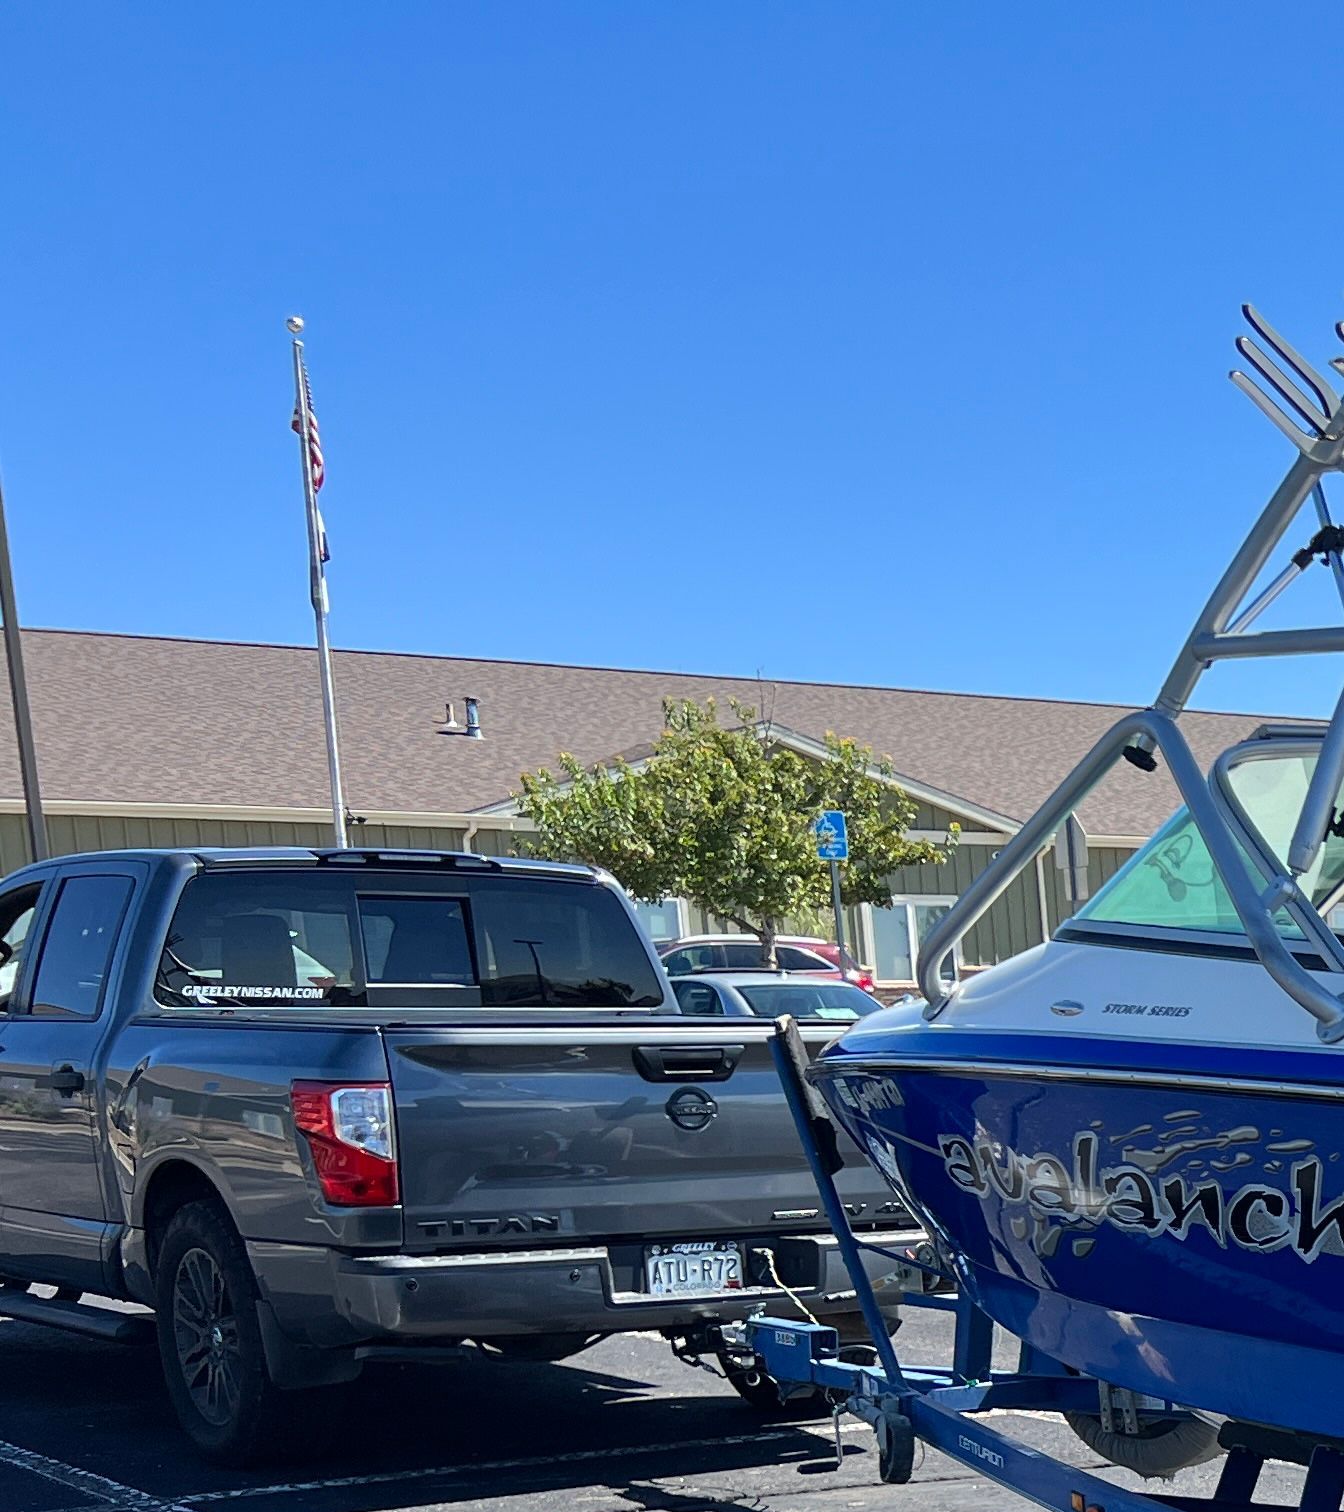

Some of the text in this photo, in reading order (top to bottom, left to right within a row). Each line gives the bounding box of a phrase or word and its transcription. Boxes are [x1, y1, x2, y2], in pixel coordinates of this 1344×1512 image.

[181, 985, 324, 999] GREELEYNISSAN.COM
[1102, 1003, 1194, 1018] STORM SERIES
[416, 1217, 559, 1237] TITAN
[673, 1281, 721, 1291] COLORADO
